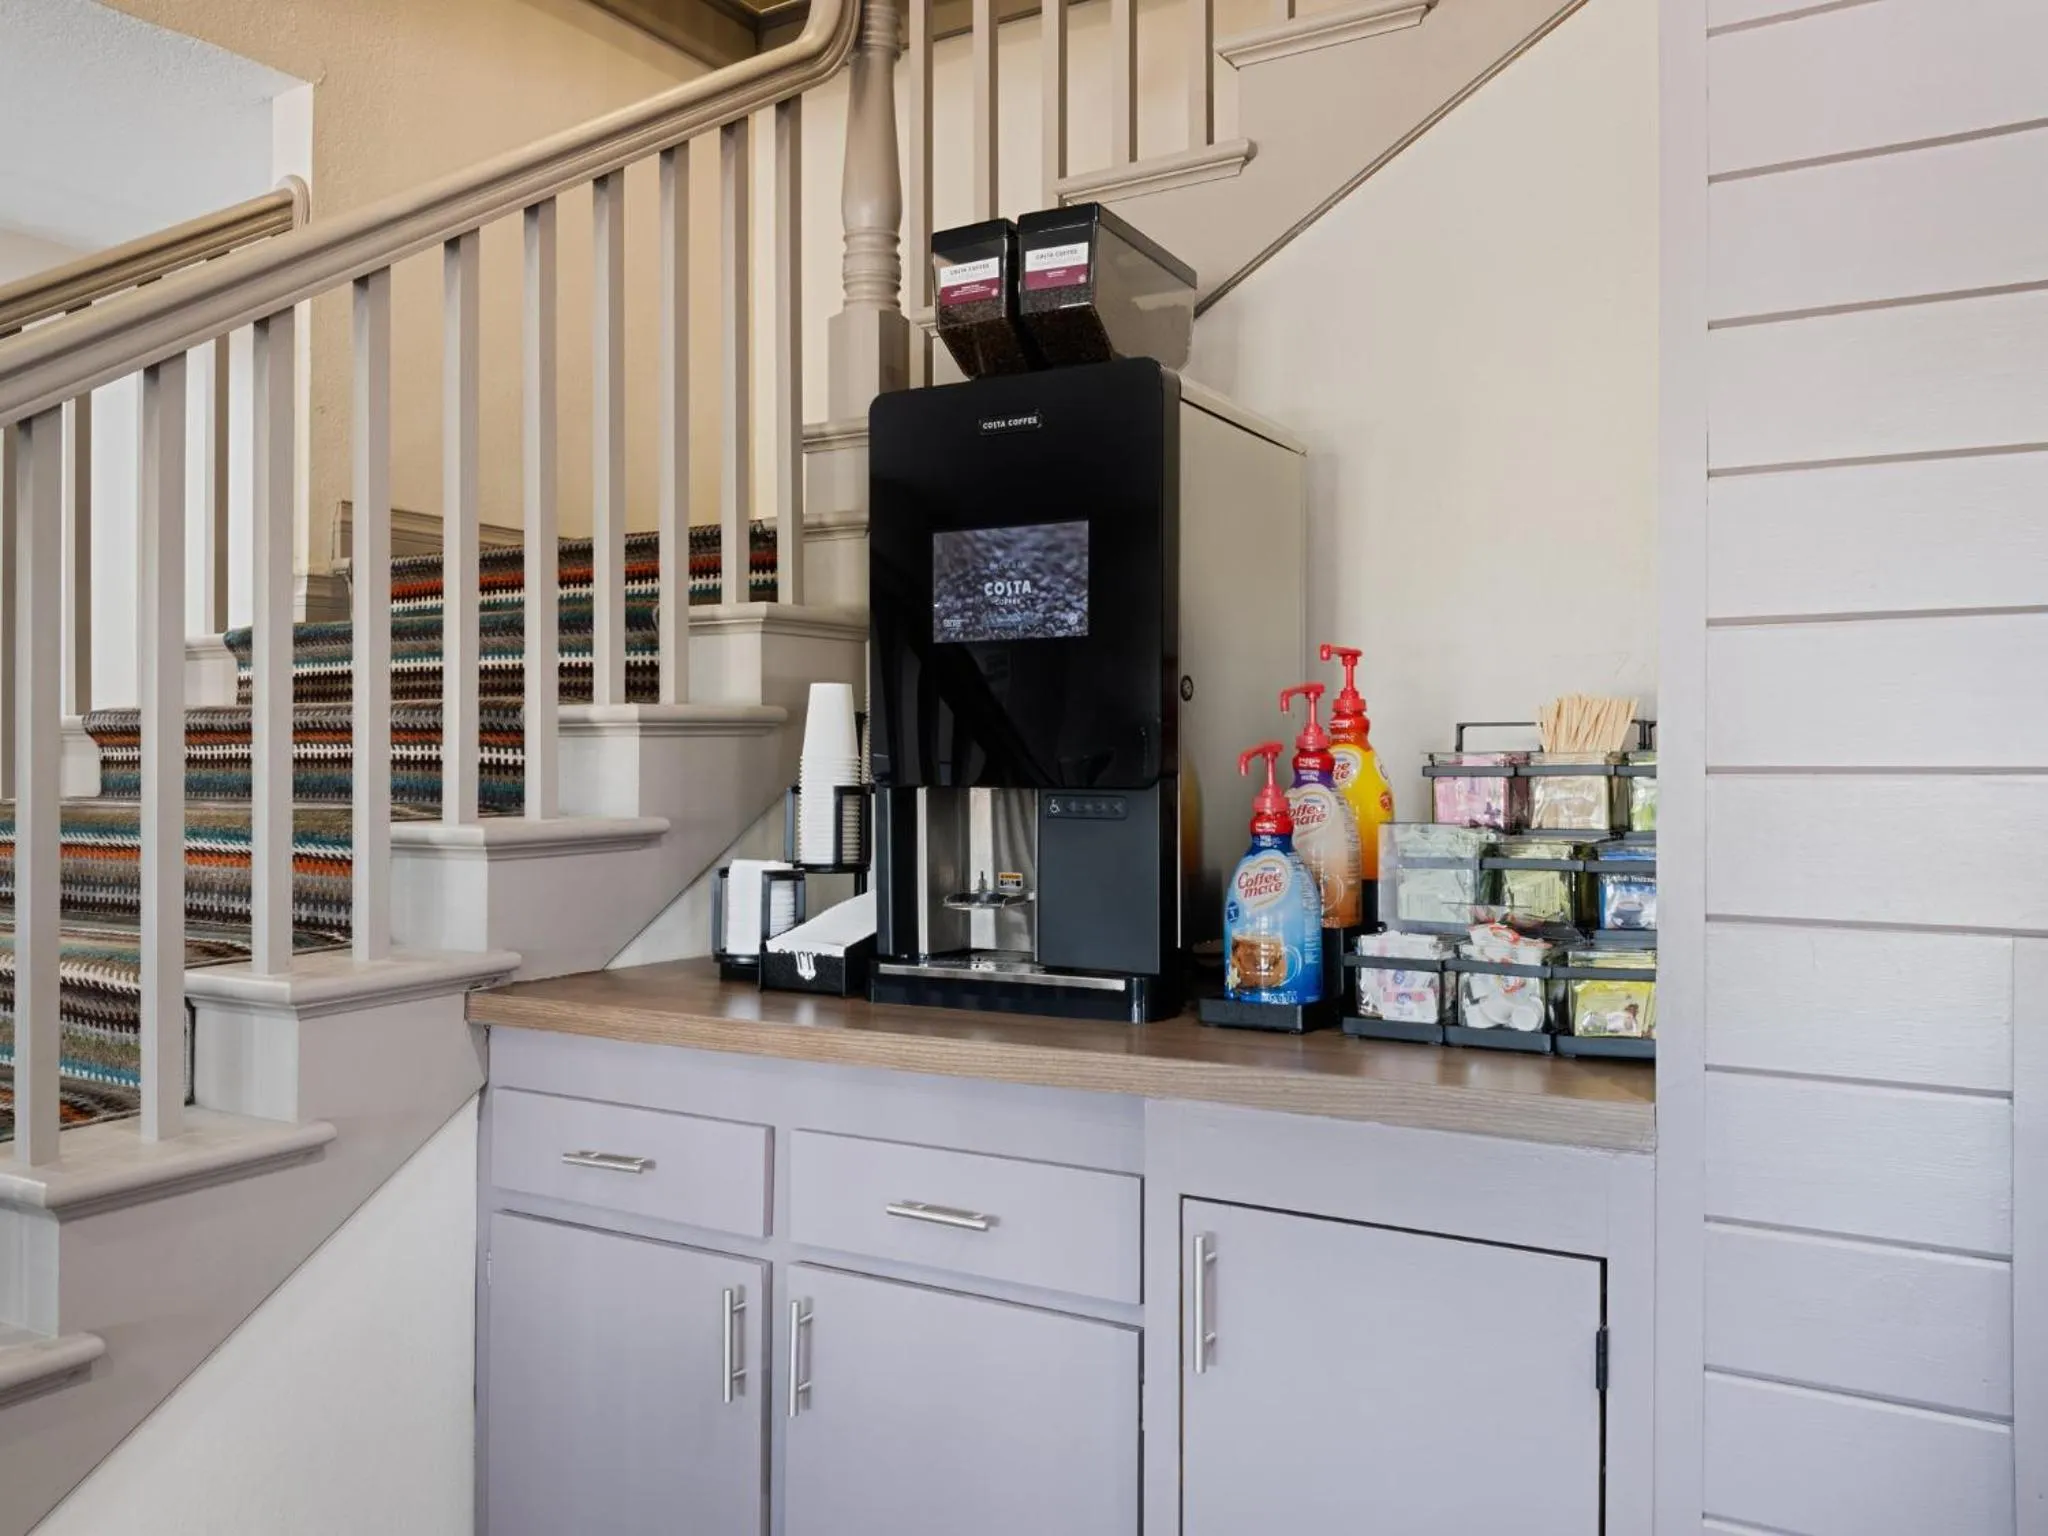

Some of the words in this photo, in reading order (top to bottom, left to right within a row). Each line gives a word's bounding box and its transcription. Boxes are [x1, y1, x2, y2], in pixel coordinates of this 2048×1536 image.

[982, 421, 1006, 430] COSTA
[1008, 416, 1038, 427] COFFEE
[984, 580, 1032, 596] COSTA
[1288, 804, 1326, 817] offee
[1238, 871, 1282, 889] Coffee
[1244, 882, 1283, 898] mate
